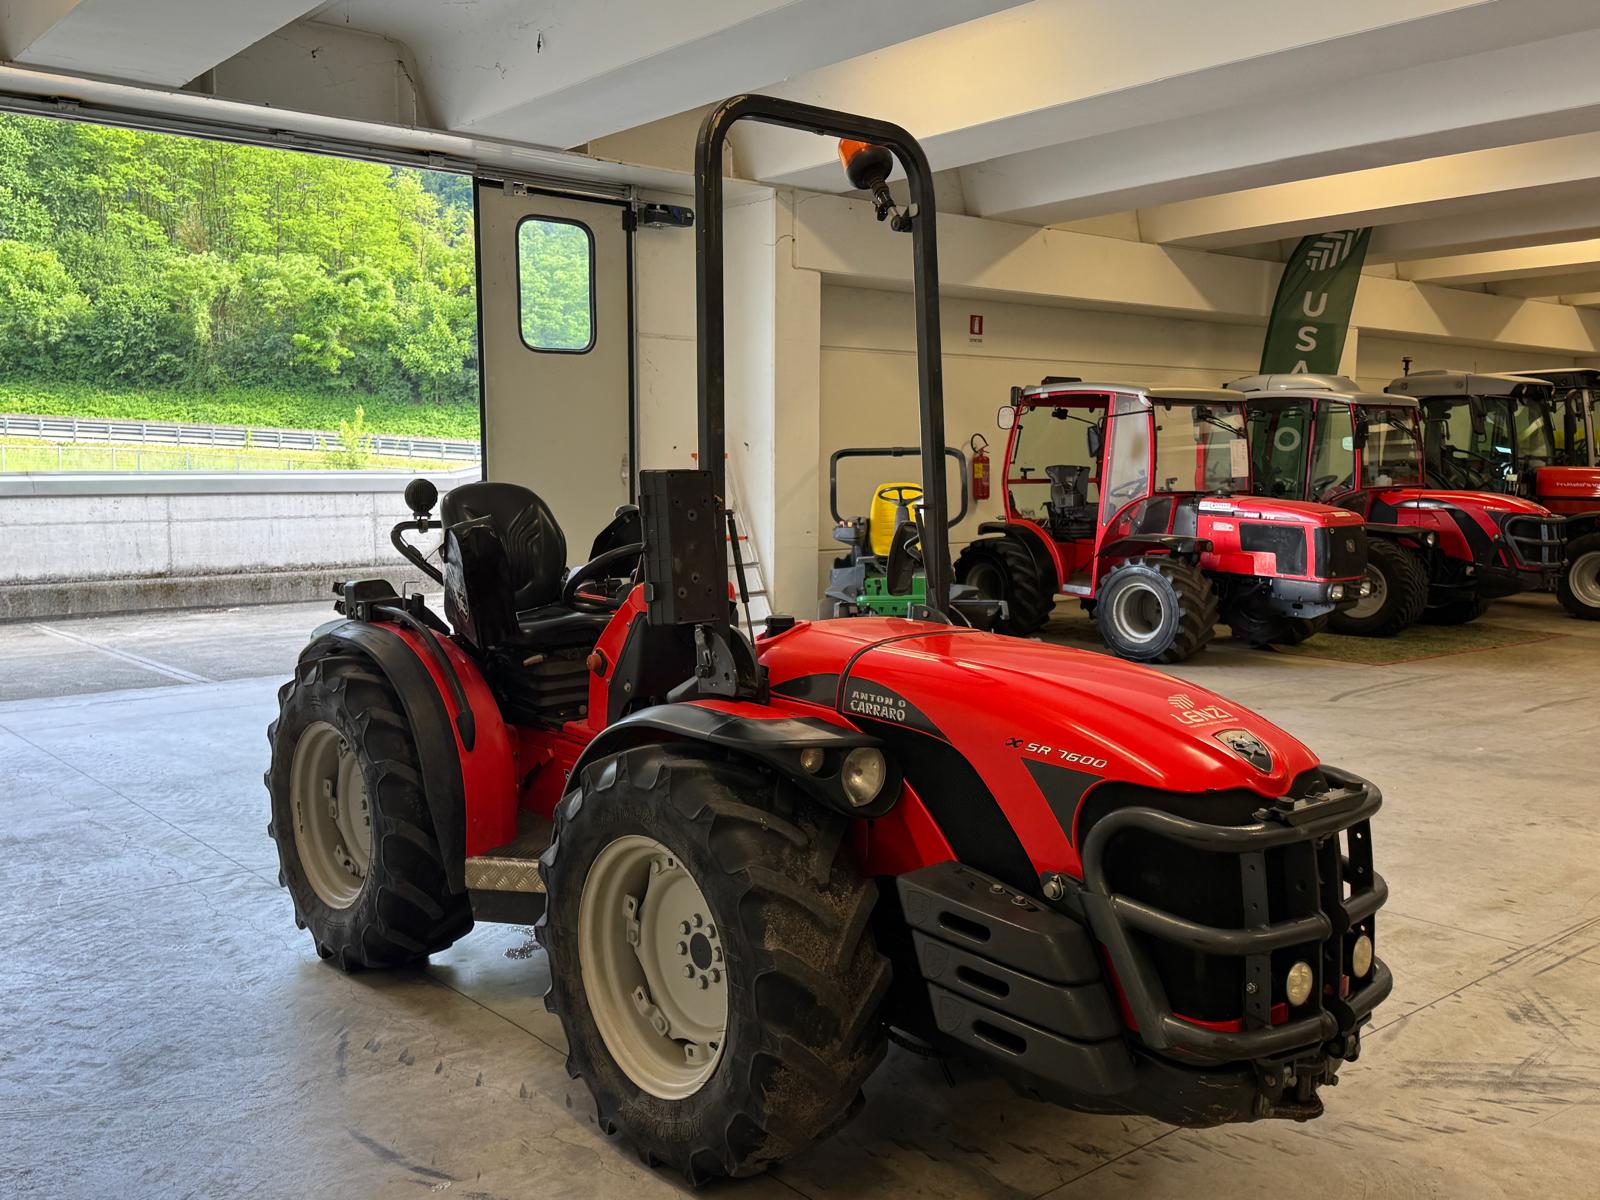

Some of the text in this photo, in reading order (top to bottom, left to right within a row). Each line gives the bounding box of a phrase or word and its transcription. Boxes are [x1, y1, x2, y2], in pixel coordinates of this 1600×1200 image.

[852, 690, 906, 708] ANTONO
[850, 699, 906, 722] CARRARO
[1169, 705, 1233, 725] LENZI
[1025, 743, 1052, 756] SR
[1057, 749, 1108, 769] 7600
